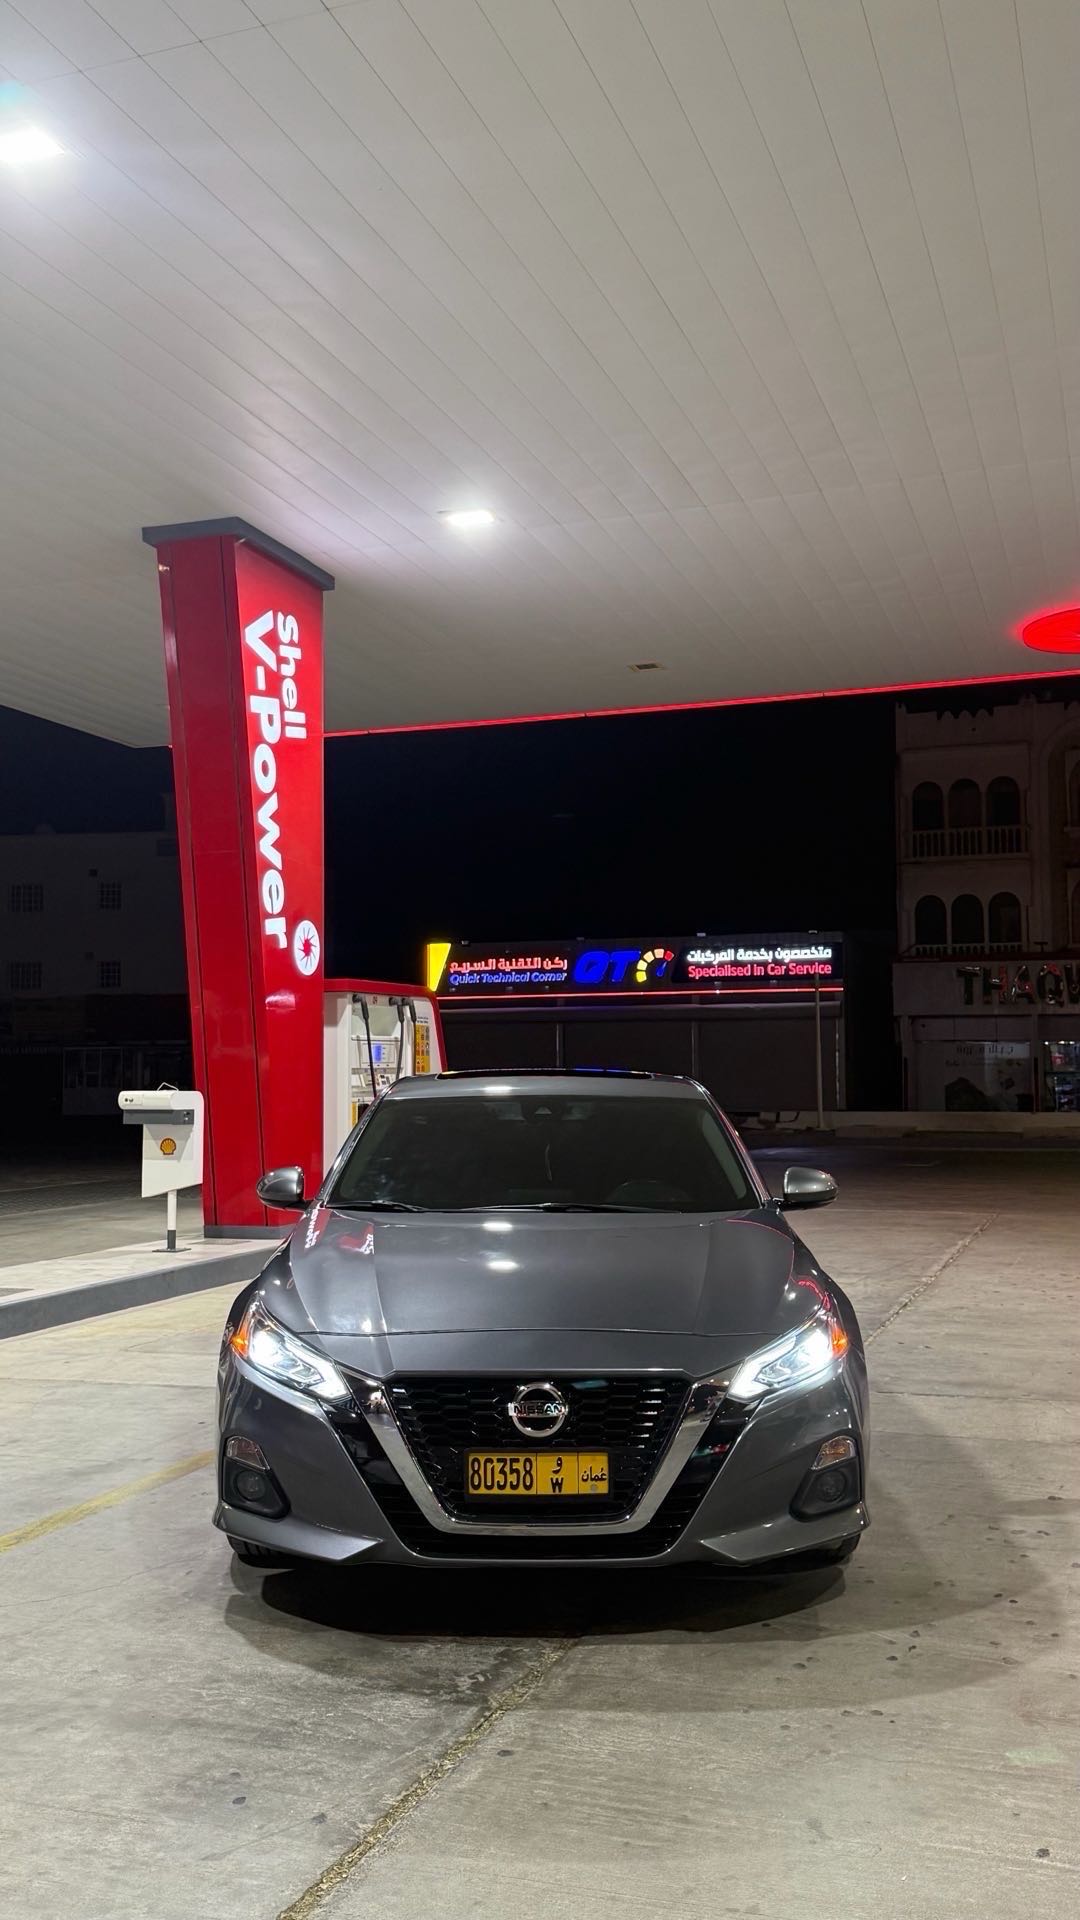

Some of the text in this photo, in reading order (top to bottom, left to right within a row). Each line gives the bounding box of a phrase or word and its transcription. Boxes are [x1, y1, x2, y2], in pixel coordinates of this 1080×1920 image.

[277, 611, 307, 740] Shell
[244, 610, 287, 949] V-Power
[687, 946, 832, 964] متخصصون بخدمة المركبات
[449, 957, 568, 973] ركن التقنية السريع
[688, 964, 751, 979] Specialised
[767, 963, 786, 975] Car
[788, 963, 832, 975] Service
[450, 972, 567, 985] Quick Technical Corner
[513, 1403, 563, 1415] NISSAN
[470, 1457, 533, 1491] 80358
